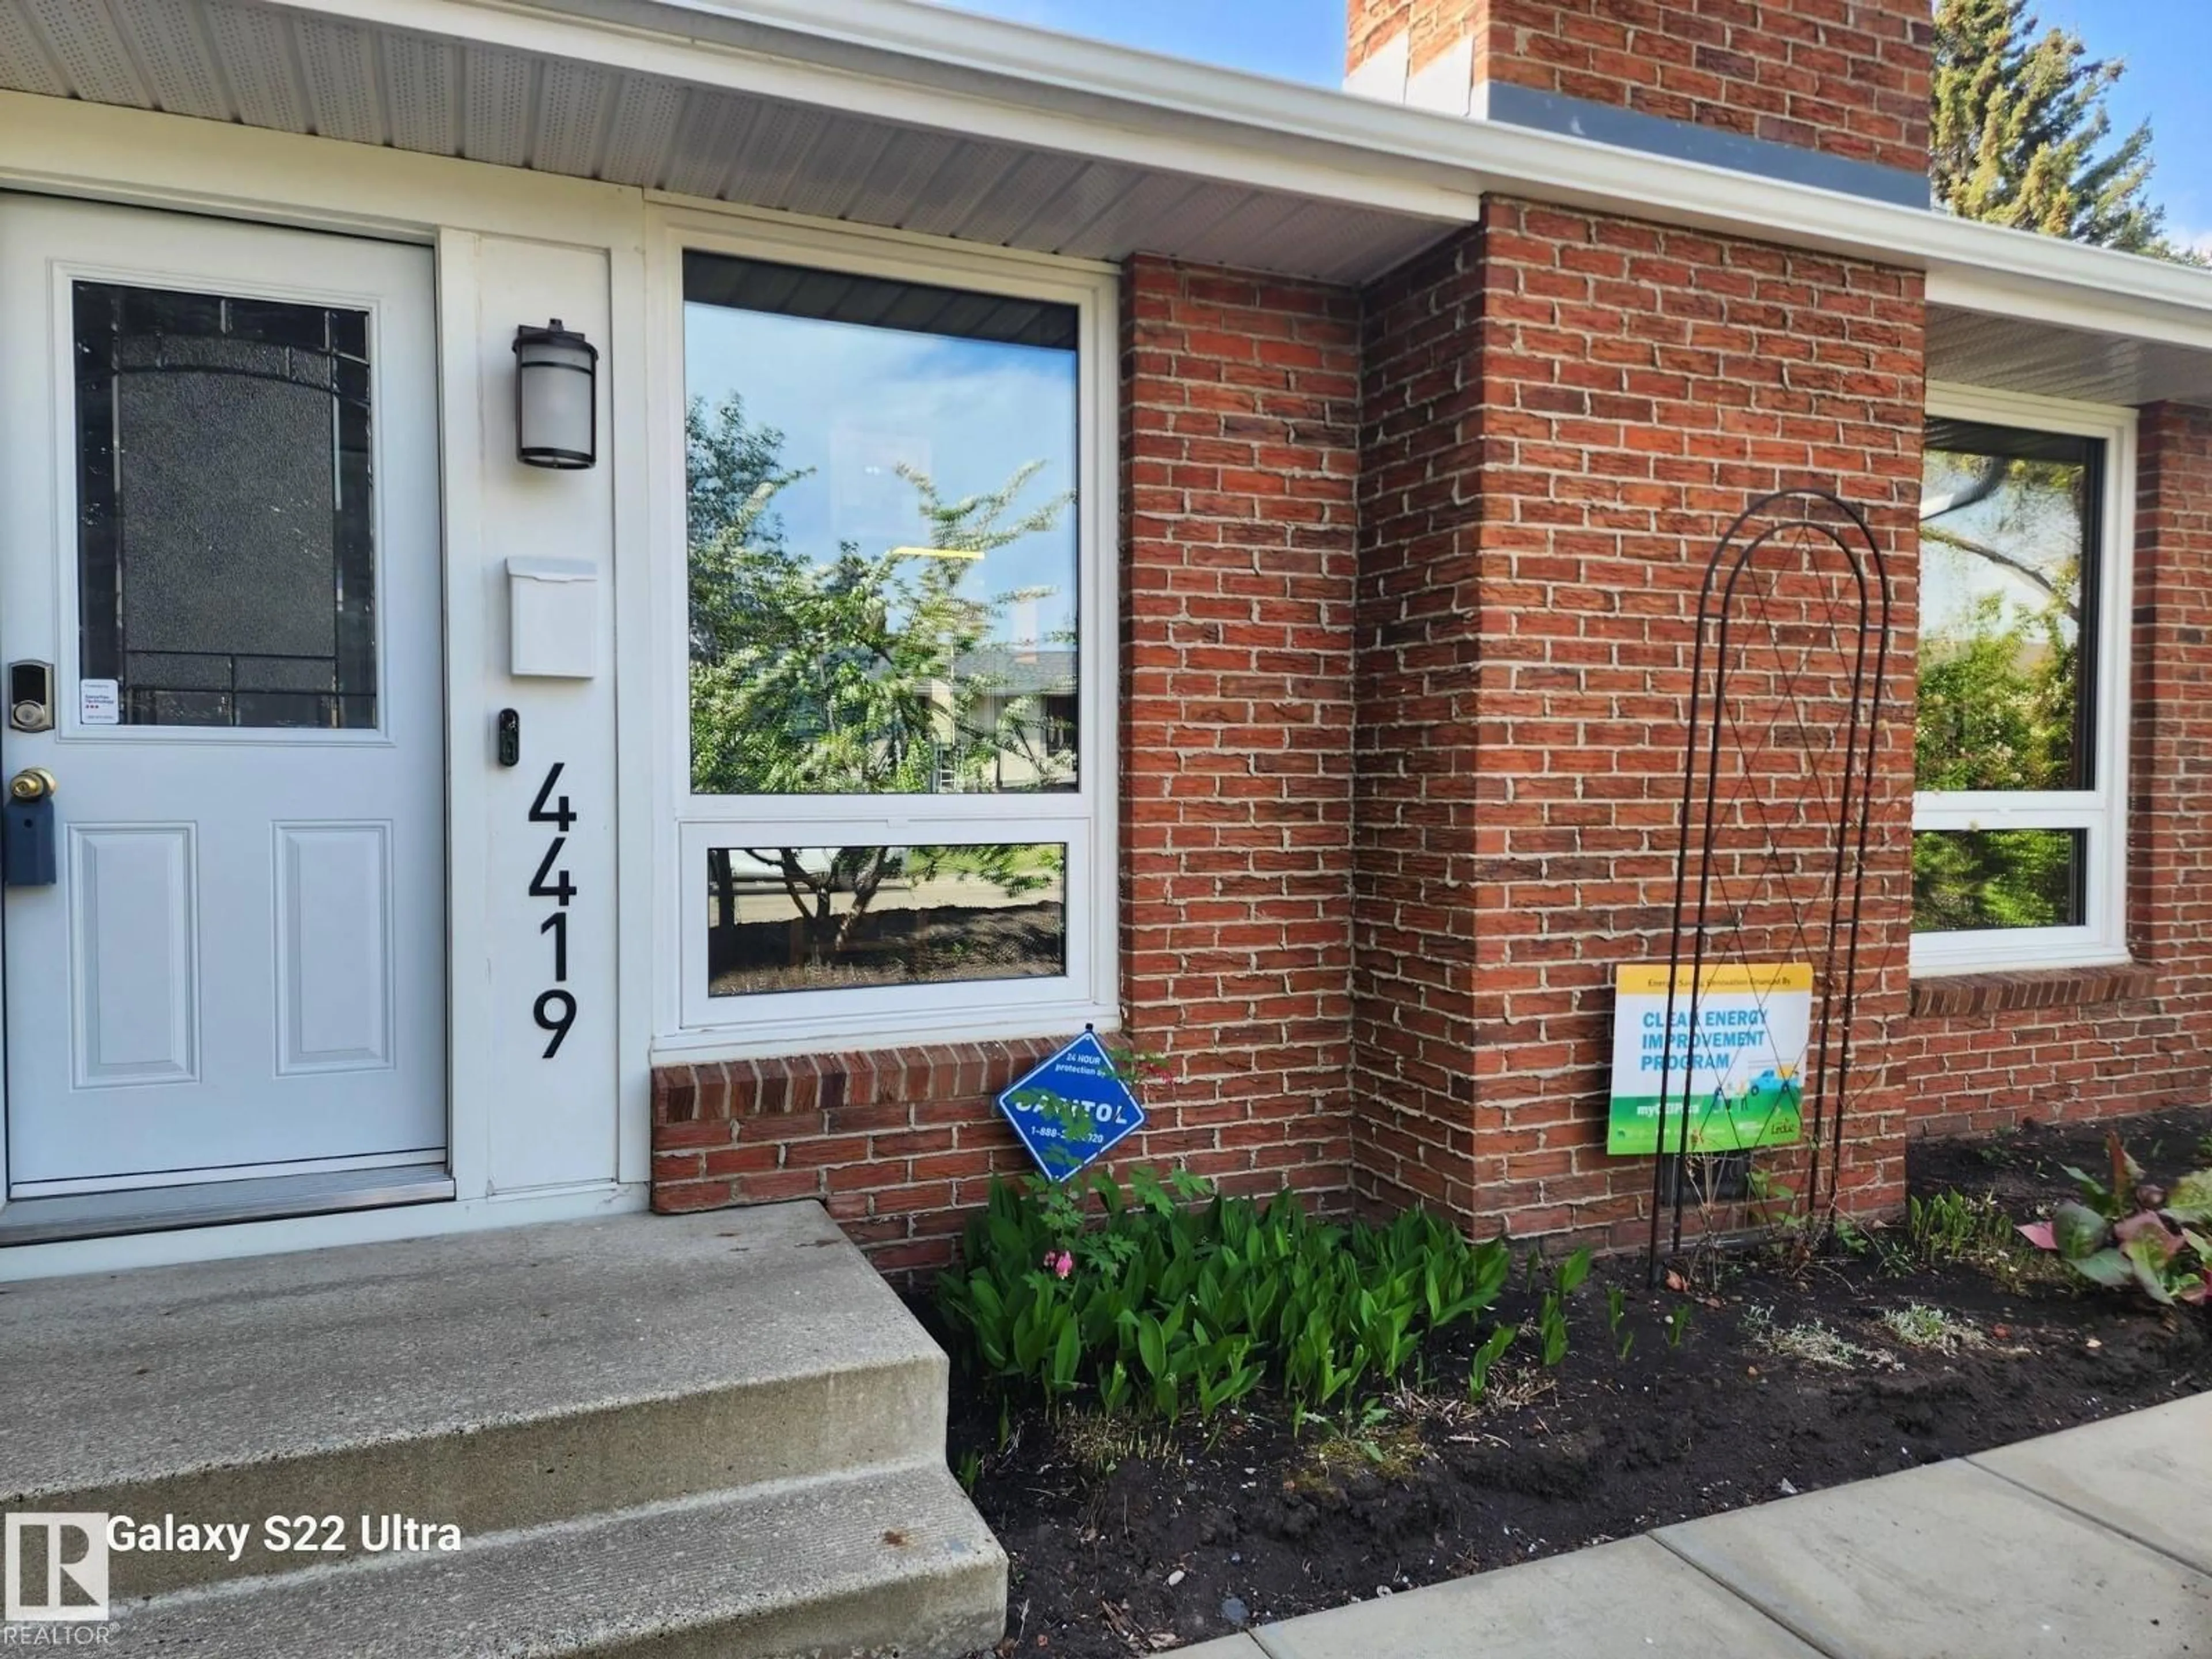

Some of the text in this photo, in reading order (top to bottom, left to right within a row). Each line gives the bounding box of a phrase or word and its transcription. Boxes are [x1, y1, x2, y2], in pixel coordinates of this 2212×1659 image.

[528, 762, 578, 1059] 4419
[1705, 1009, 1767, 1027] ENERGY
[1642, 1031, 1765, 1050] IMPROVEMENT
[1066, 1052, 1101, 1065] 24 HOUR
[1641, 1054, 1730, 1071] PROGRAM
[1055, 1063, 1096, 1075] protection
